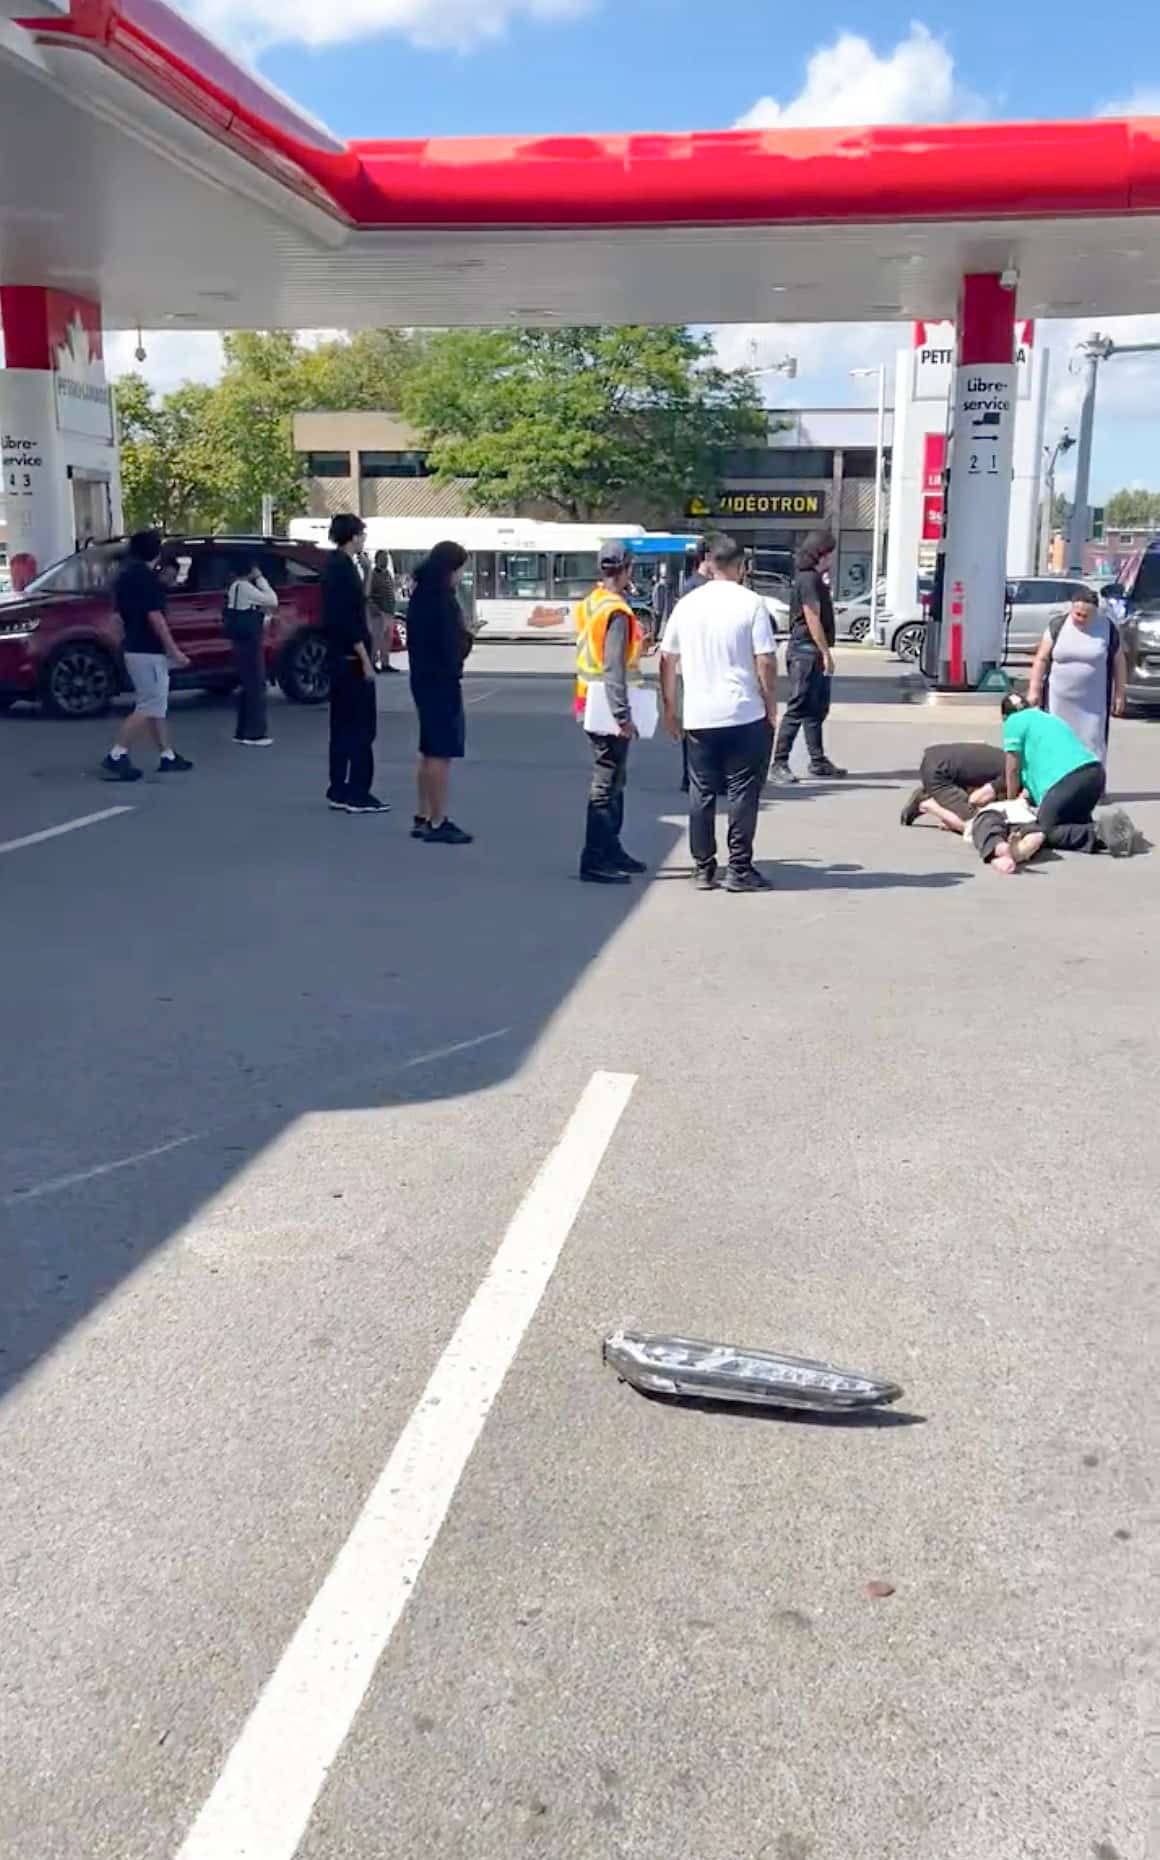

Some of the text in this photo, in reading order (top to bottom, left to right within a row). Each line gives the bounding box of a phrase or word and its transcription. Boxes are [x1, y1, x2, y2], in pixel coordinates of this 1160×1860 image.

[967, 378, 1008, 393] Libre-
[963, 396, 1010, 411] service
[2, 453, 43, 467] ervice
[970, 454, 978, 469] 2
[22, 473, 31, 487] 3
